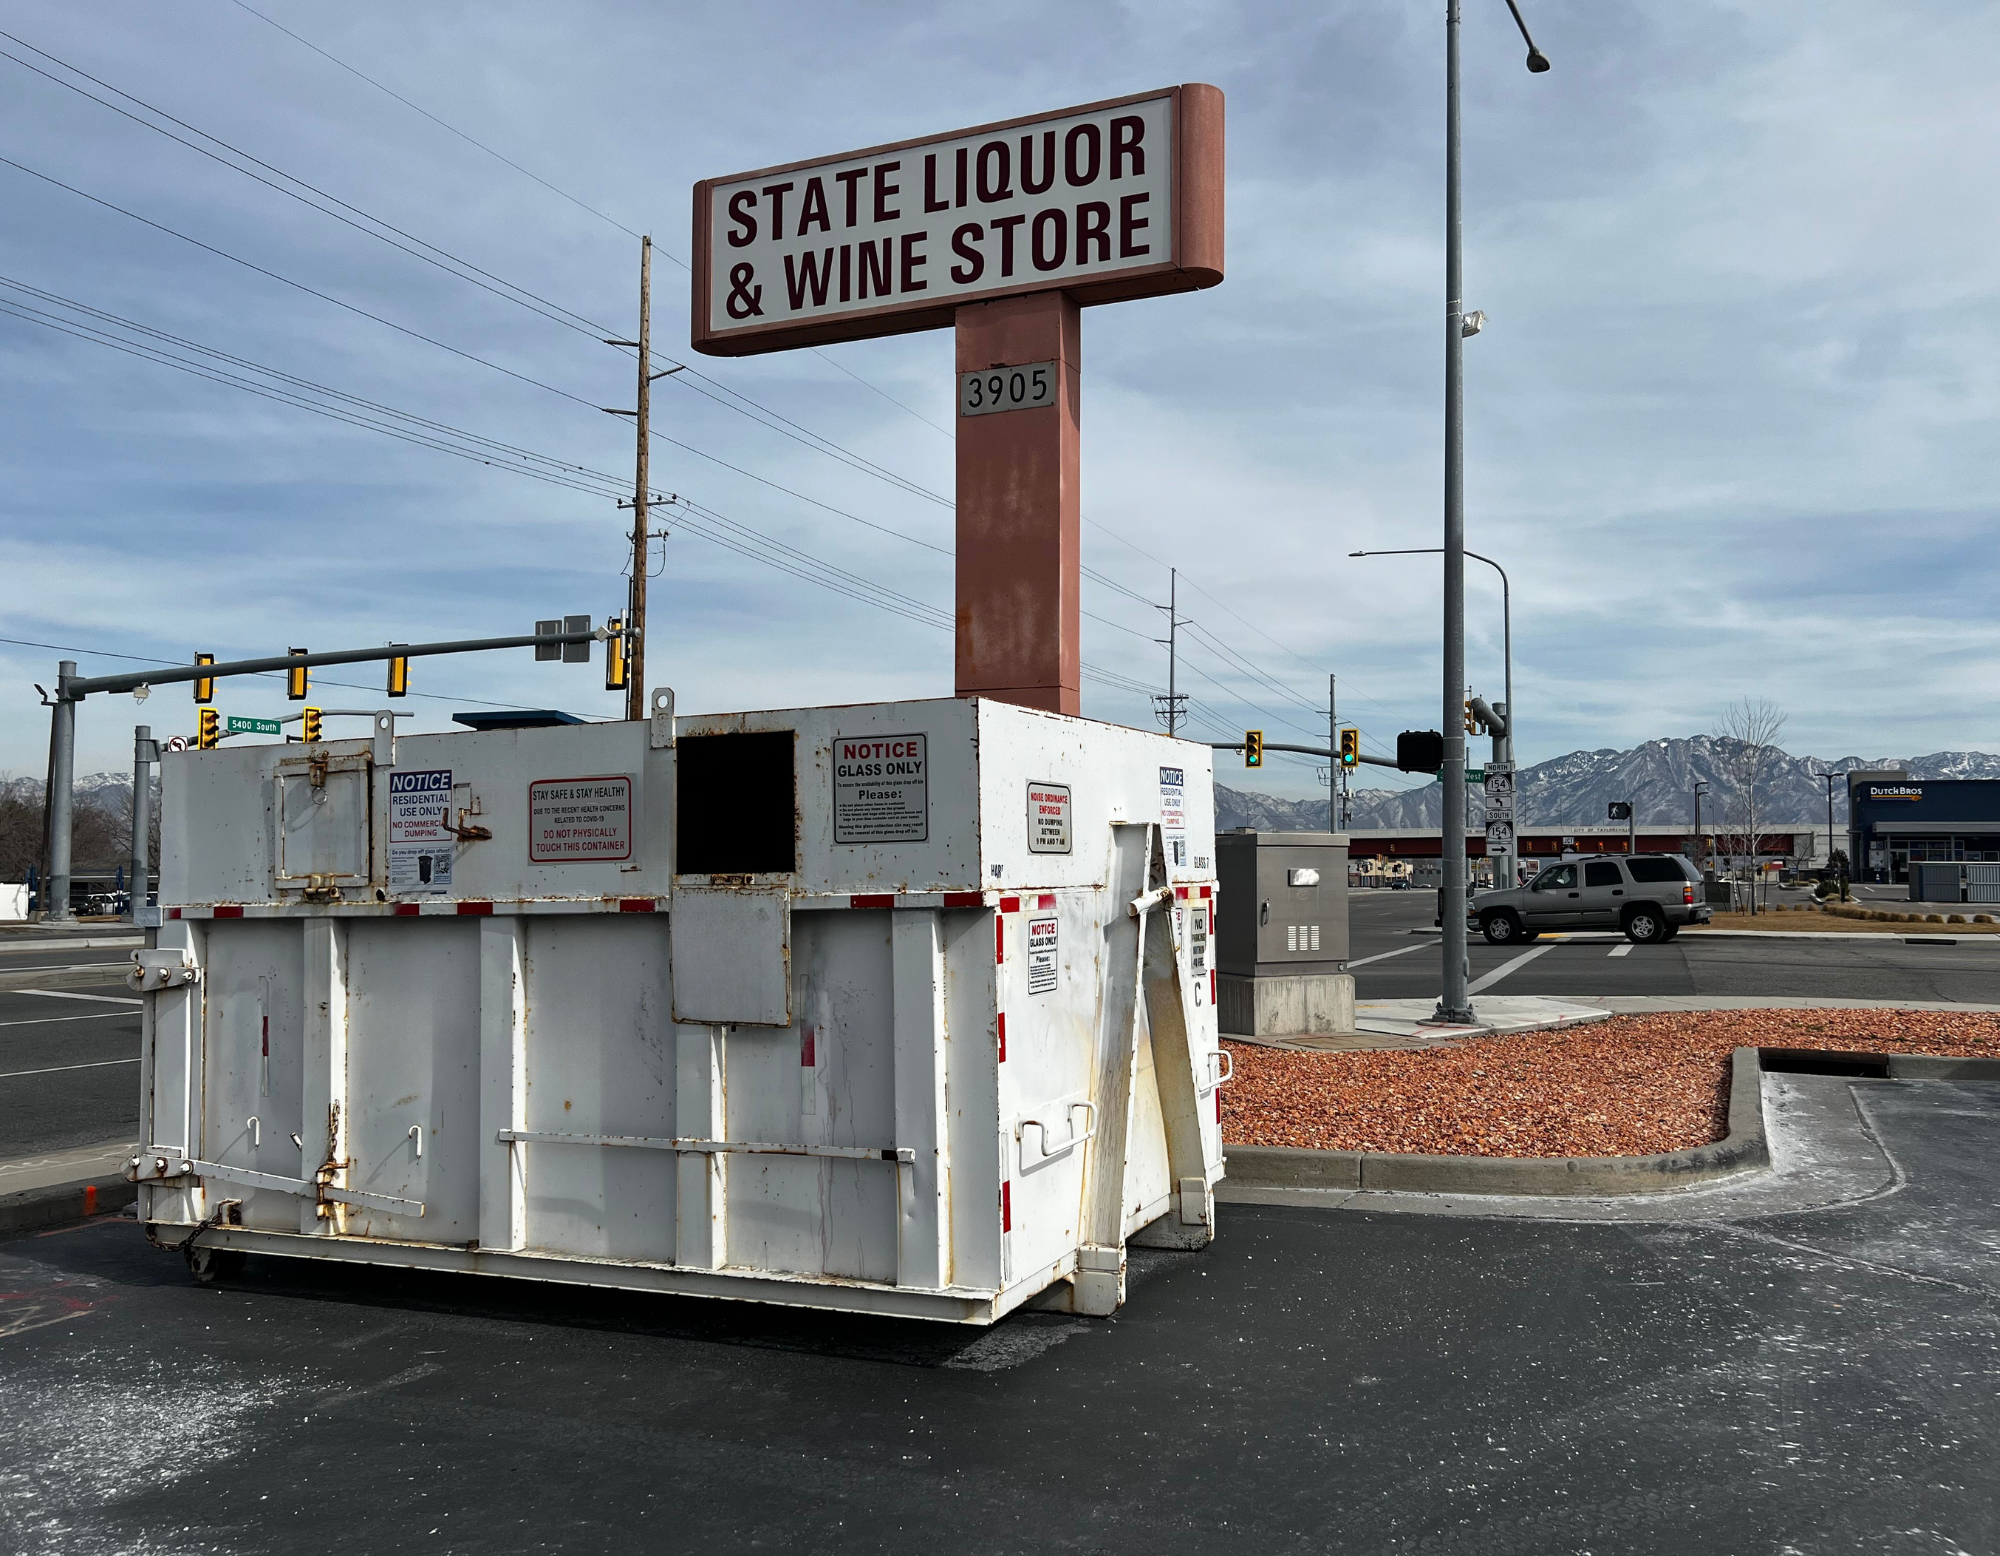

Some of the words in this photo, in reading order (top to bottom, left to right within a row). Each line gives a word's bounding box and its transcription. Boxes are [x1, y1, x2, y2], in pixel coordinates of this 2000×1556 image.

[727, 160, 900, 248] STATE
[924, 115, 1146, 214] LIQUOR
[726, 262, 764, 320] &
[784, 231, 928, 312] WINE
[950, 192, 1151, 284] STORE
[968, 368, 1047, 408] 3905
[232, 720, 251, 729] 5400
[256, 722, 276, 731] South
[844, 742, 917, 760] NOTICE
[838, 764, 882, 777] GLASS
[886, 761, 922, 775] ONLY
[392, 773, 450, 791] NOTICE
[1161, 770, 1183, 785] NOTICE
[1491, 780, 1506, 788] 154
[533, 790, 549, 800] STAY
[551, 789, 568, 799] SAFE
[570, 789, 574, 798] &
[577, 788, 592, 798] STAY
[595, 787, 625, 797] HEALTHY
[859, 790, 902, 800] Please:
[1161, 788, 1183, 796] RESIDENTIAL
[393, 794, 450, 805] RESIDENTIAL
[1031, 792, 1043, 802] NOISE
[1045, 794, 1068, 804] ORDINANCE
[1172, 799, 1181, 807] ONLY
[400, 808, 417, 816] USE
[419, 806, 442, 816] ONLY
[1039, 805, 1061, 815] ENFORCED
[404, 820, 446, 828] COMMERCI
[544, 830, 554, 839] DO
[556, 829, 571, 838] NOT
[573, 828, 617, 838] PHYSICALLY
[1492, 827, 1506, 836] 154
[536, 843, 561, 852] TOUCH
[564, 842, 579, 851] THIS
[582, 841, 625, 851] CONTAINER
[1194, 856, 1206, 869] GLASS
[1032, 923, 1055, 935] NOTICE
[1195, 919, 1202, 929] NO
[1030, 937, 1044, 947] GLASS
[1045, 936, 1057, 946] ONLY
